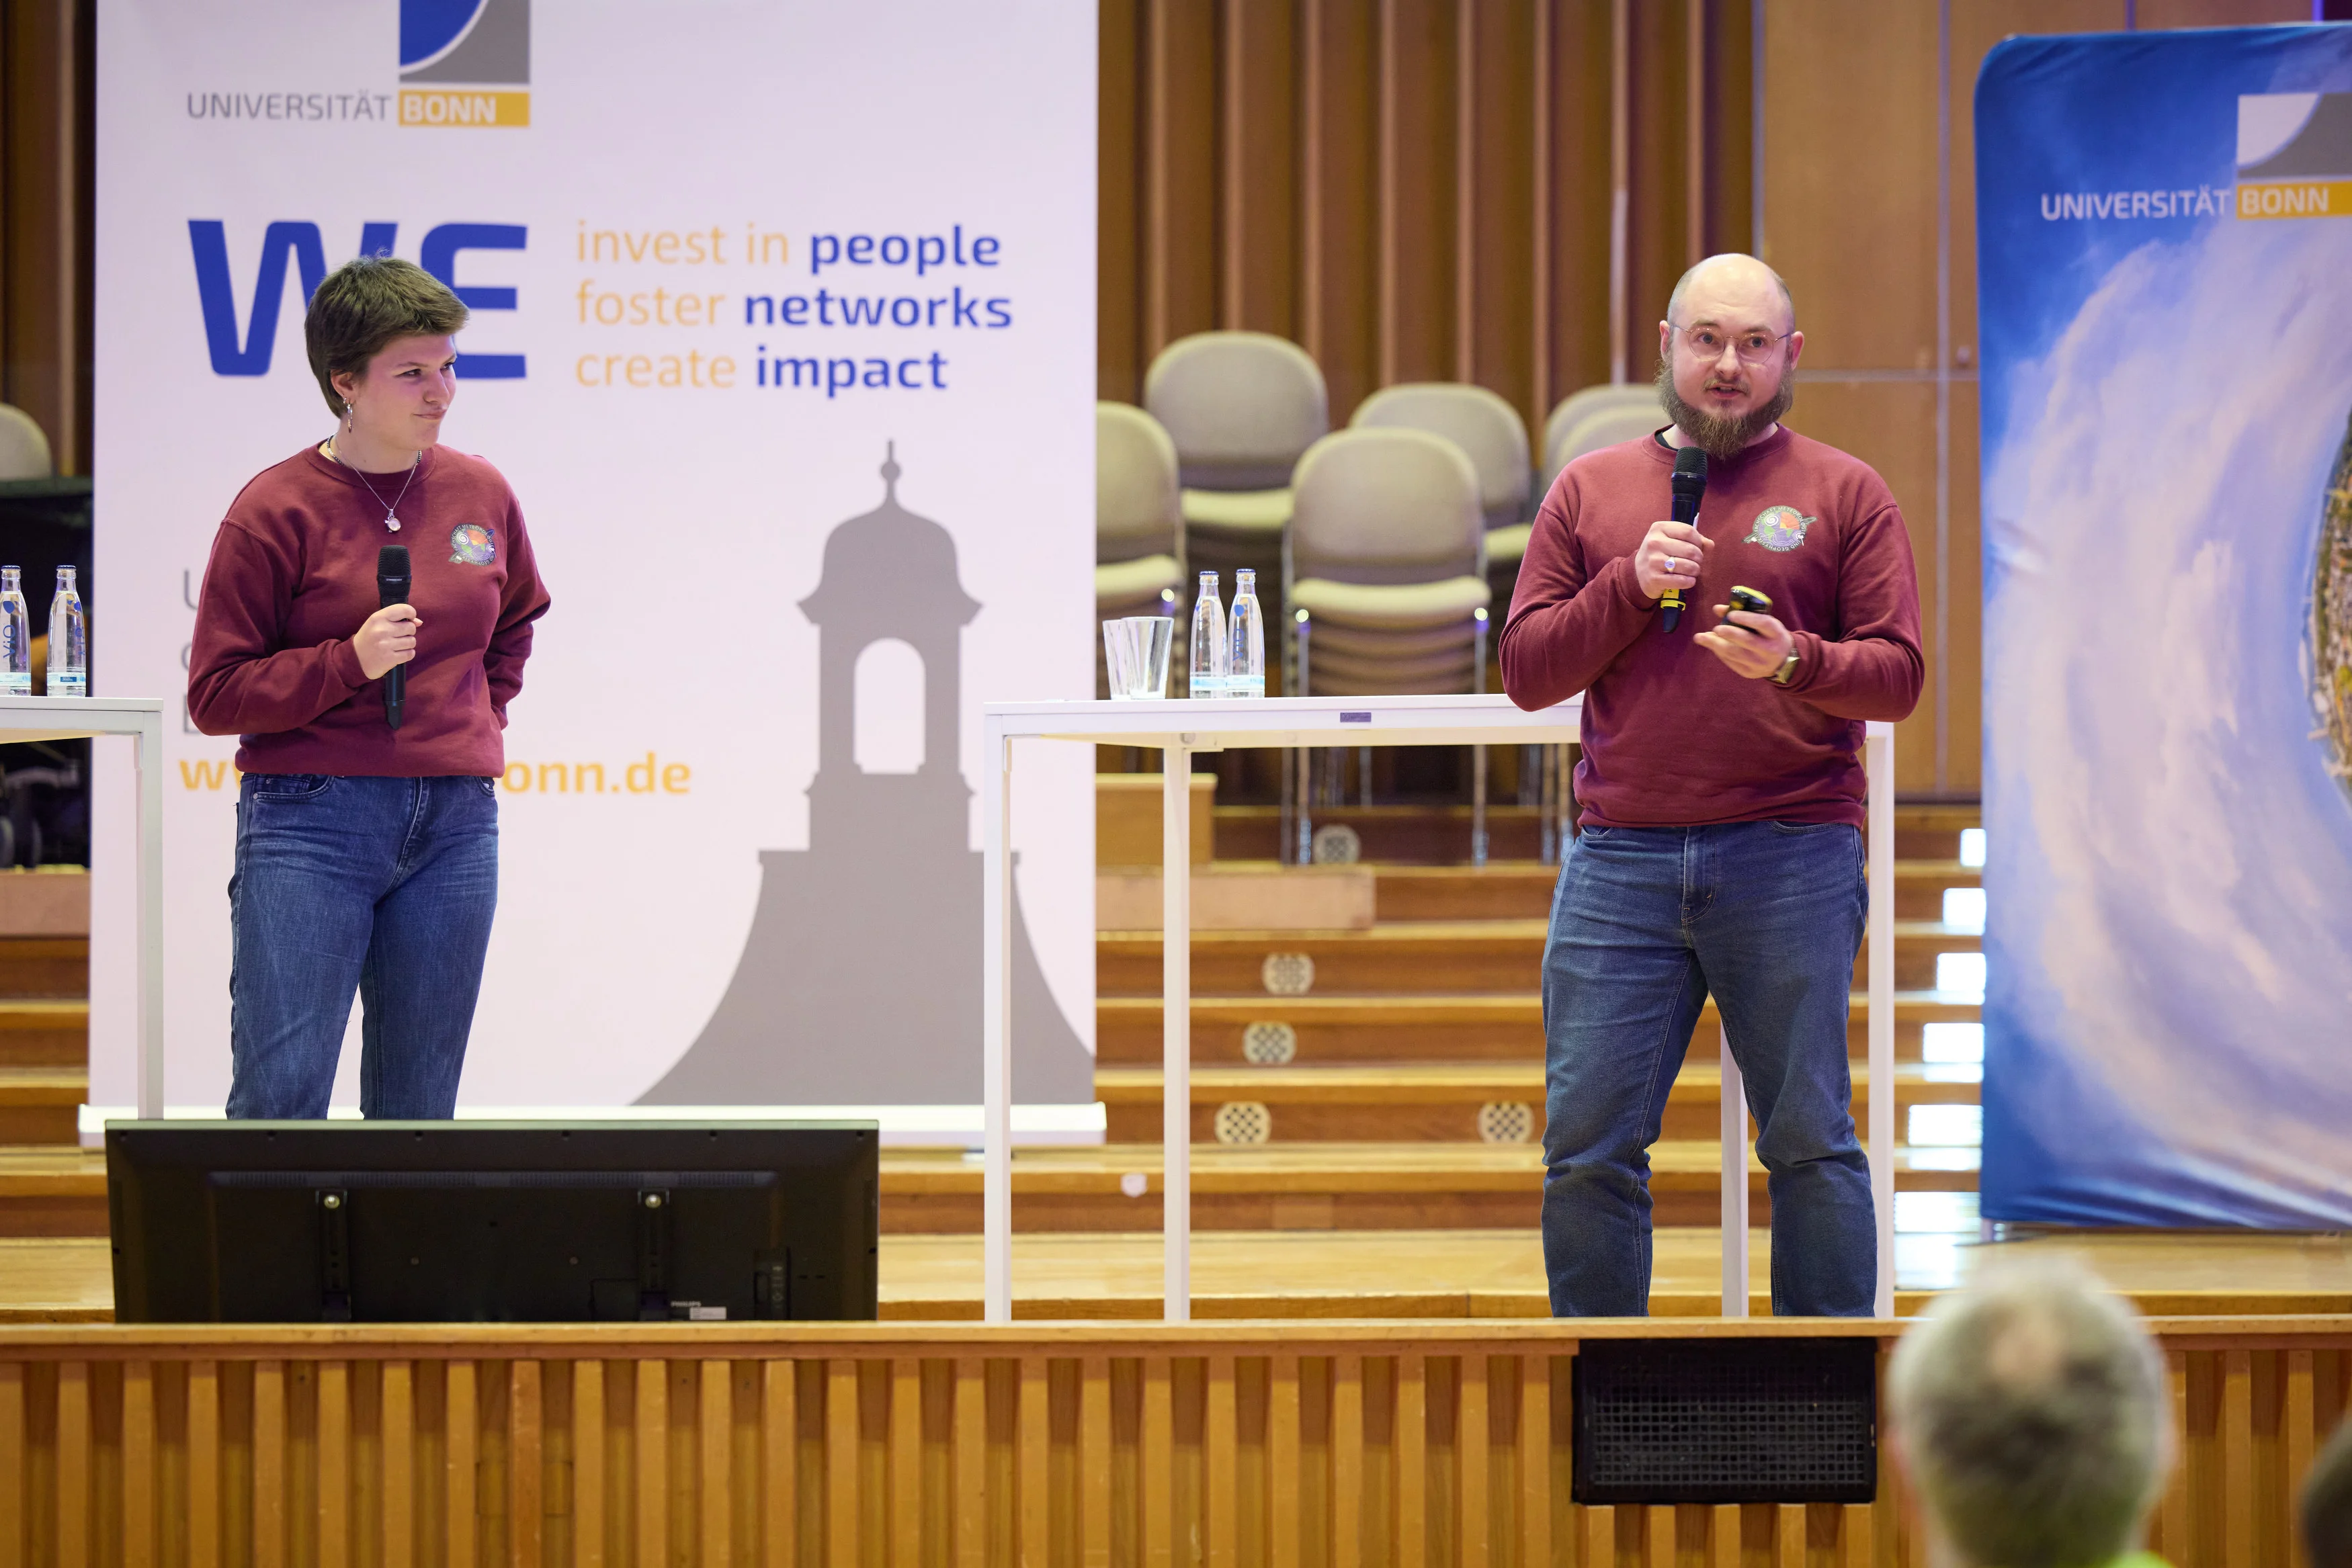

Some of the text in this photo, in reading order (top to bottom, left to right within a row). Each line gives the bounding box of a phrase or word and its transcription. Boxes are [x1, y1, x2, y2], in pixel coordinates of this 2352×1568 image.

[187, 89, 497, 124] UNIVERSITÄT BONN
[2040, 183, 2330, 221] UNIVERSITÄT BONN
[576, 219, 1001, 277] invest in people
[188, 220, 528, 379] WE
[575, 278, 1013, 329] foster networks
[575, 345, 948, 399] create impact
[1754, 507, 1776, 533] FACHSCHAFT
[1777, 507, 1806, 535] METEOROLOGIE
[1790, 540, 1802, 549] UND
